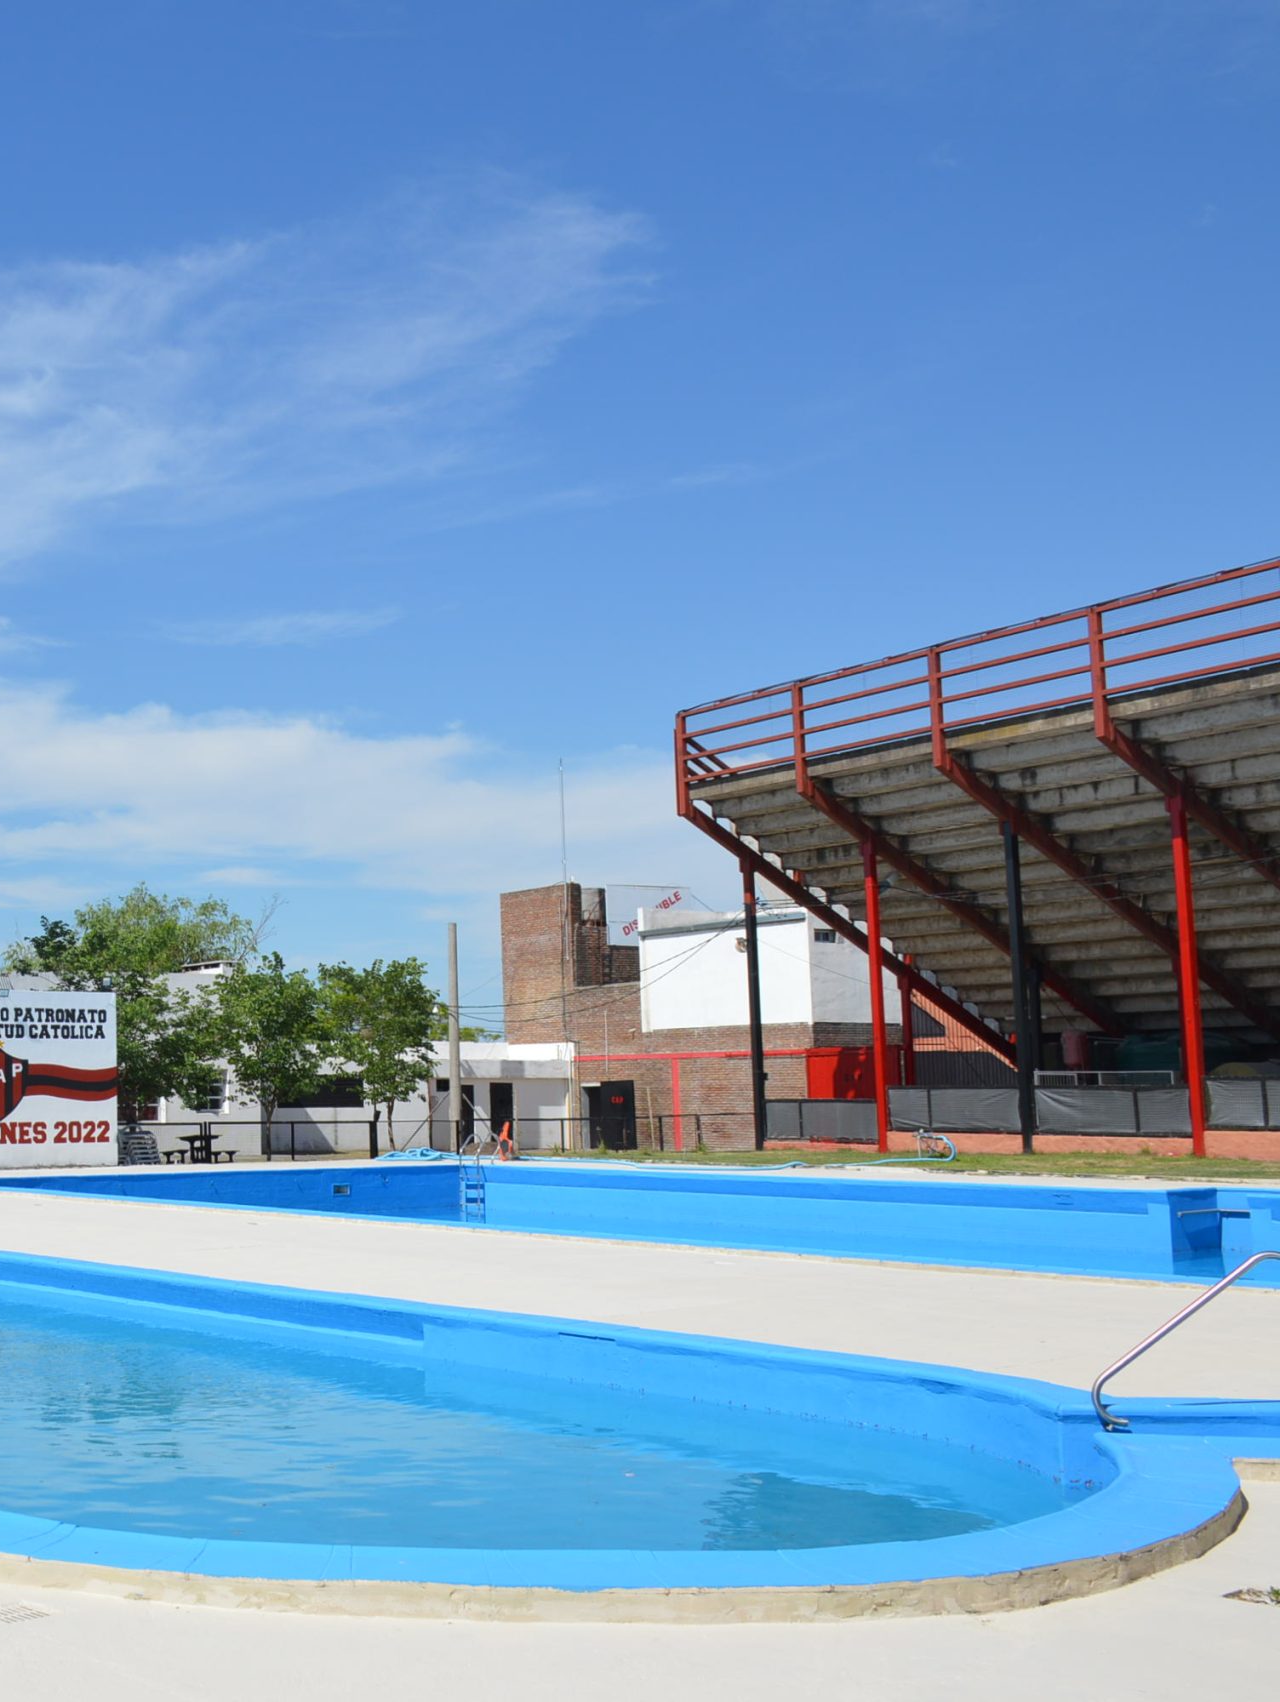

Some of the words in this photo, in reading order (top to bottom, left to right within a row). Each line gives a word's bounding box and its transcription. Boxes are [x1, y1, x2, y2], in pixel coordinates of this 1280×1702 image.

[14, 1007, 107, 1024] PATRONATO
[29, 1024, 106, 1040] CATOLICA
[53, 1120, 111, 1144] 2022
